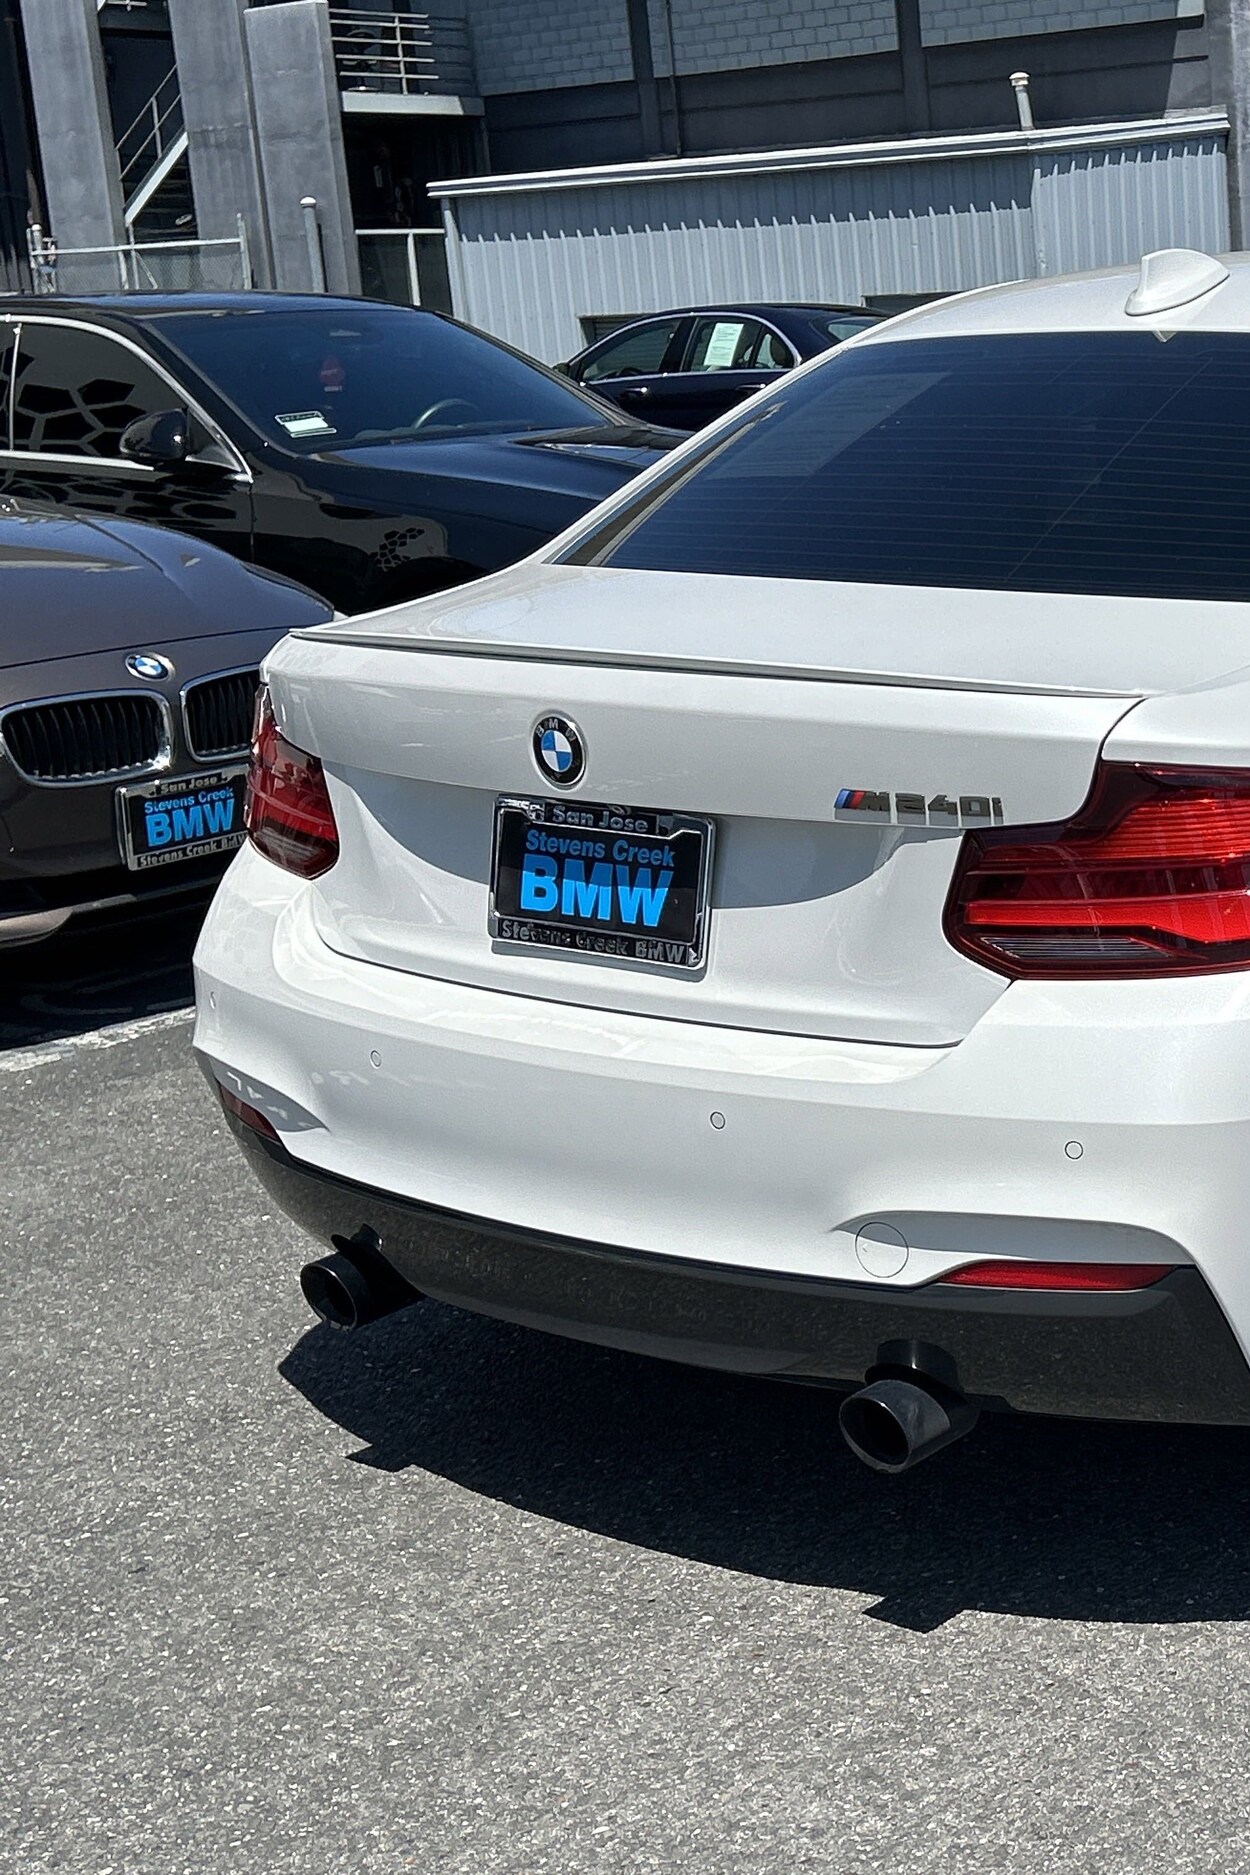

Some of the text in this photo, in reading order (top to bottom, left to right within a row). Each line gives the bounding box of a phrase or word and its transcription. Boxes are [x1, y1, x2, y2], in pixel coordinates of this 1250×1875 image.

[534, 718, 577, 742] BMW
[160, 775, 218, 794] San Jose
[144, 786, 234, 814] Stevens Creek
[145, 798, 235, 848] BMW
[552, 804, 649, 833] San Jose
[140, 850, 184, 867] Stevens
[186, 841, 218, 856] Creek
[525, 829, 677, 867] Stevens Creek
[520, 852, 675, 927] BMW
[575, 931, 630, 956] Creek
[635, 939, 686, 964] BMW
